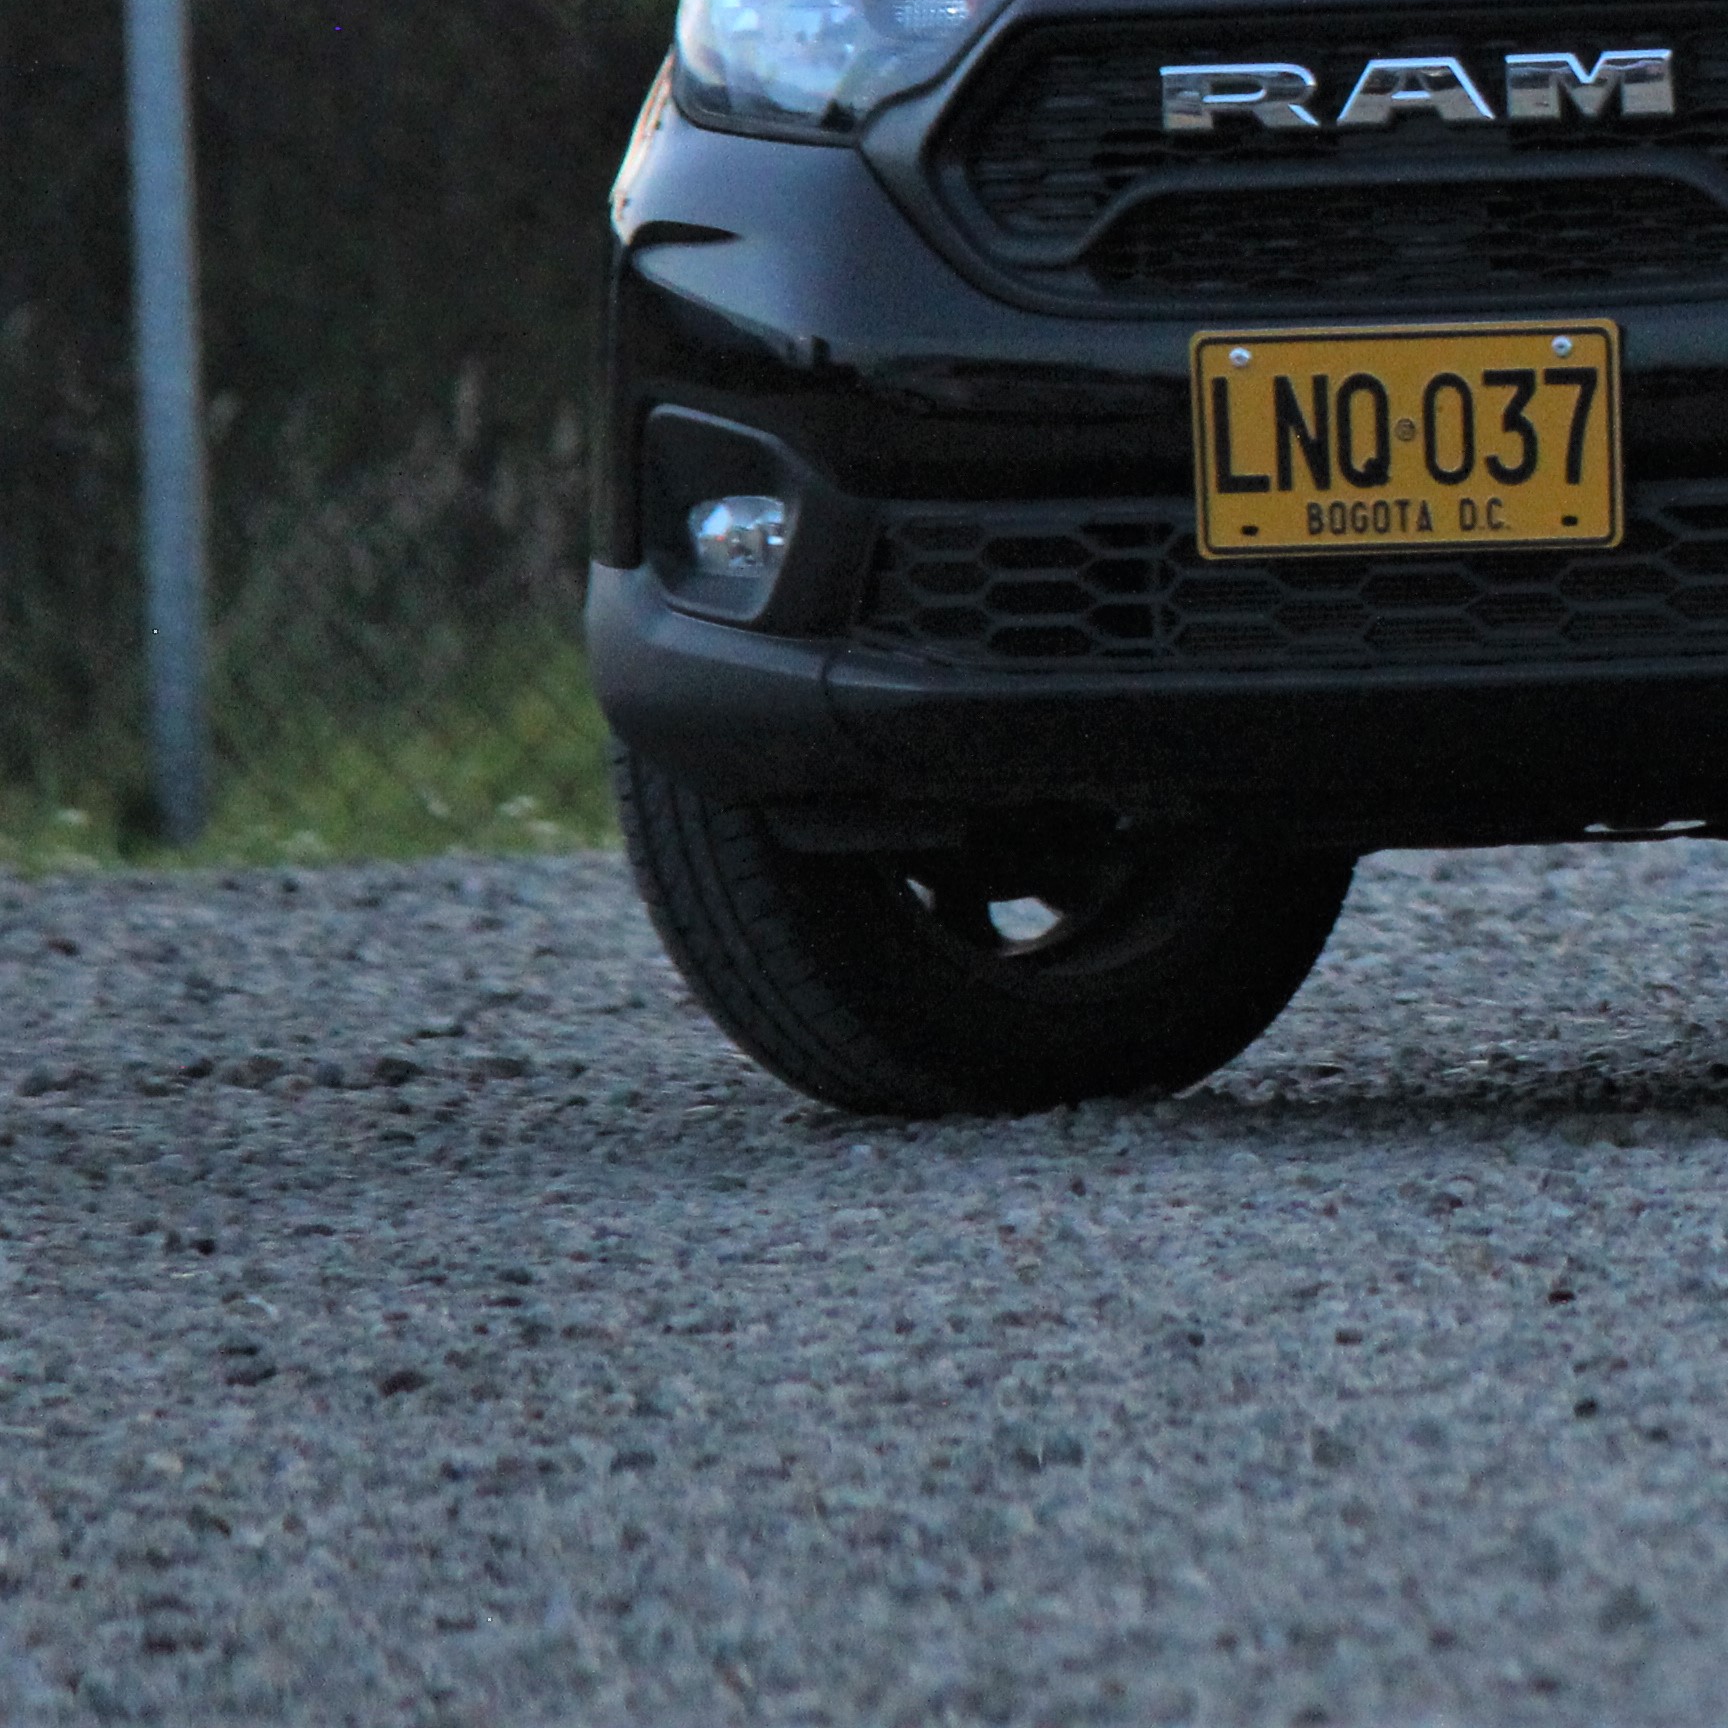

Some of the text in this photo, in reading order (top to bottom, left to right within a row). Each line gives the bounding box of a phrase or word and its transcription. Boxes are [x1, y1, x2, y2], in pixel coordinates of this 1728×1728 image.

[1159, 48, 1675, 132] RAM
[1210, 367, 1599, 494] LNQ 037
[1305, 498, 1435, 536] BOGOTA
